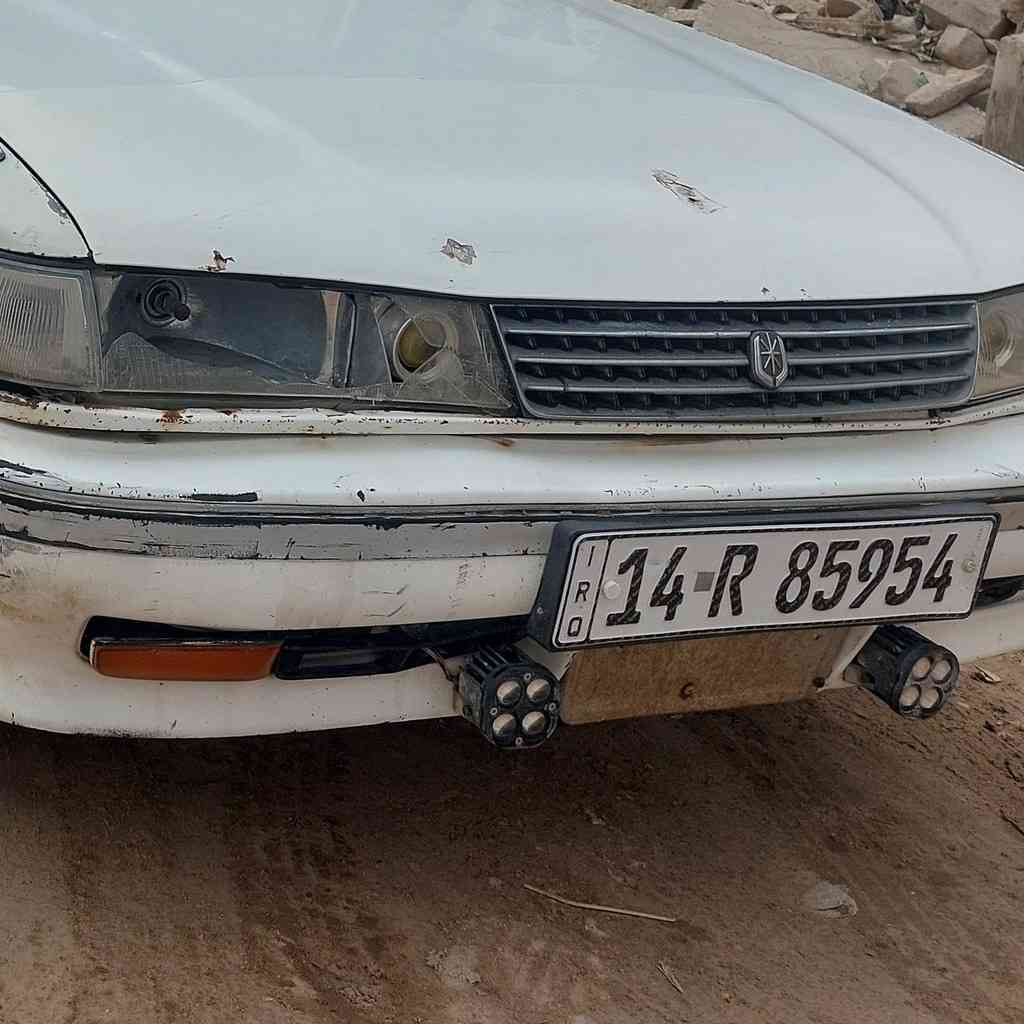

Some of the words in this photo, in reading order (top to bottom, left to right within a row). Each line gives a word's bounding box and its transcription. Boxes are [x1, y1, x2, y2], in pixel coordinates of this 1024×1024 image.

[606, 545, 688, 627] 14
[708, 544, 759, 618] R
[776, 532, 960, 615] 85954
